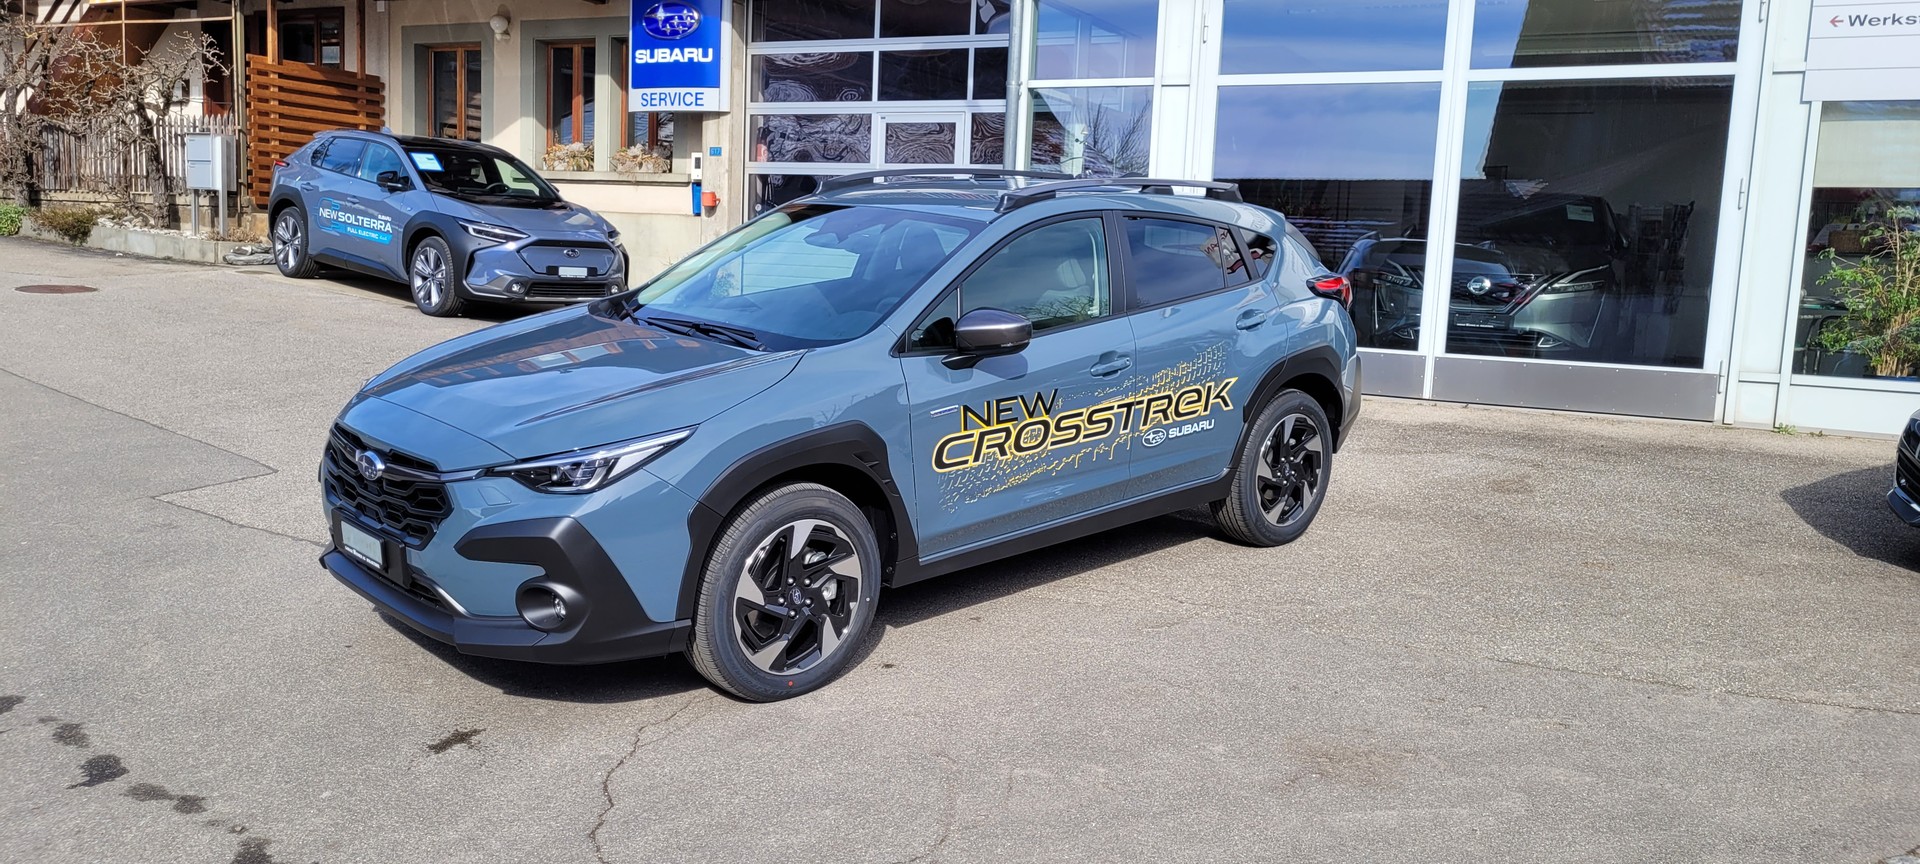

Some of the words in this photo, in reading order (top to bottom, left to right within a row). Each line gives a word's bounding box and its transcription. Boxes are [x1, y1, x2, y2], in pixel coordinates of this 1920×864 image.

[635, 48, 713, 64] SUBARU
[641, 92, 705, 107] SERVICE
[319, 207, 338, 220] NEW
[338, 211, 393, 233] SOLTERRA
[358, 229, 379, 239] ELECTRIC
[961, 388, 1059, 431] NEW
[1168, 419, 1215, 439] SUBARU
